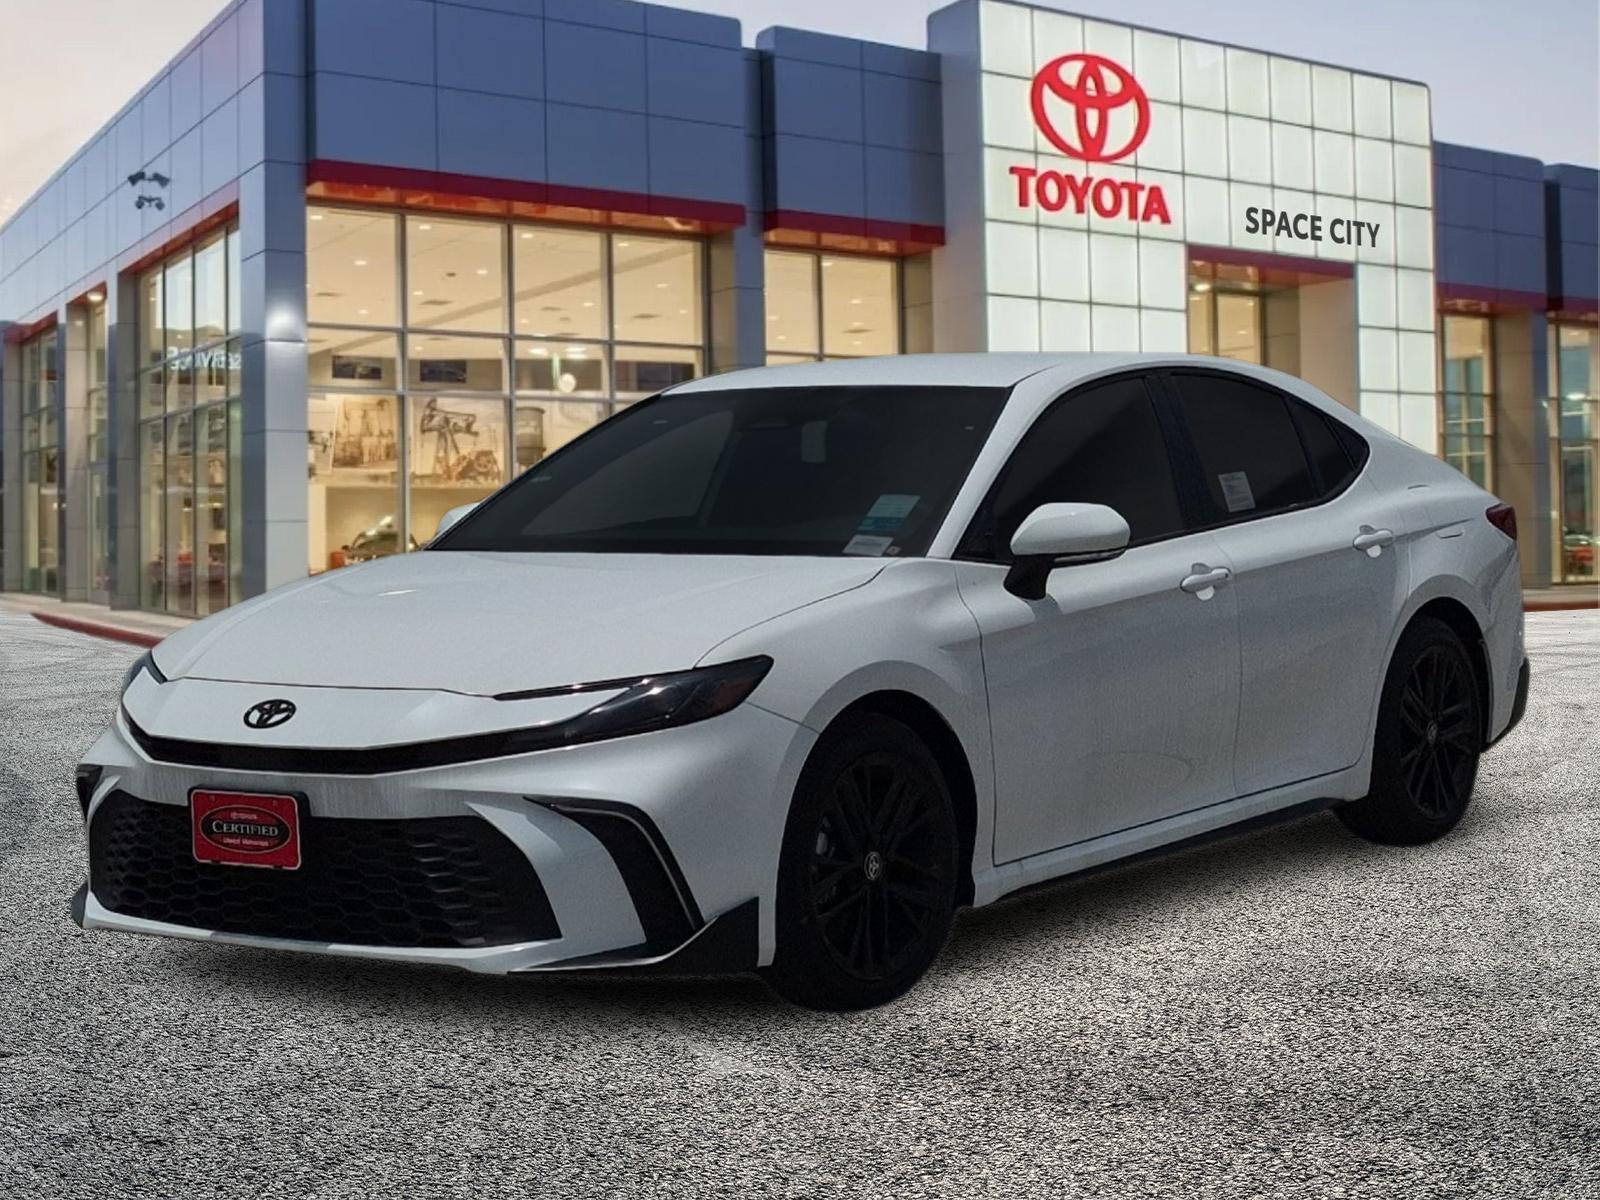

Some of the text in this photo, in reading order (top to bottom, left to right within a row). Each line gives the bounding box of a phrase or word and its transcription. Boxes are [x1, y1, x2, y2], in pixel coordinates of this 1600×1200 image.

[1009, 166, 1171, 224] TOYOTA
[1245, 206, 1380, 248] SPACE CITY
[212, 820, 279, 836] CERTIFIED
